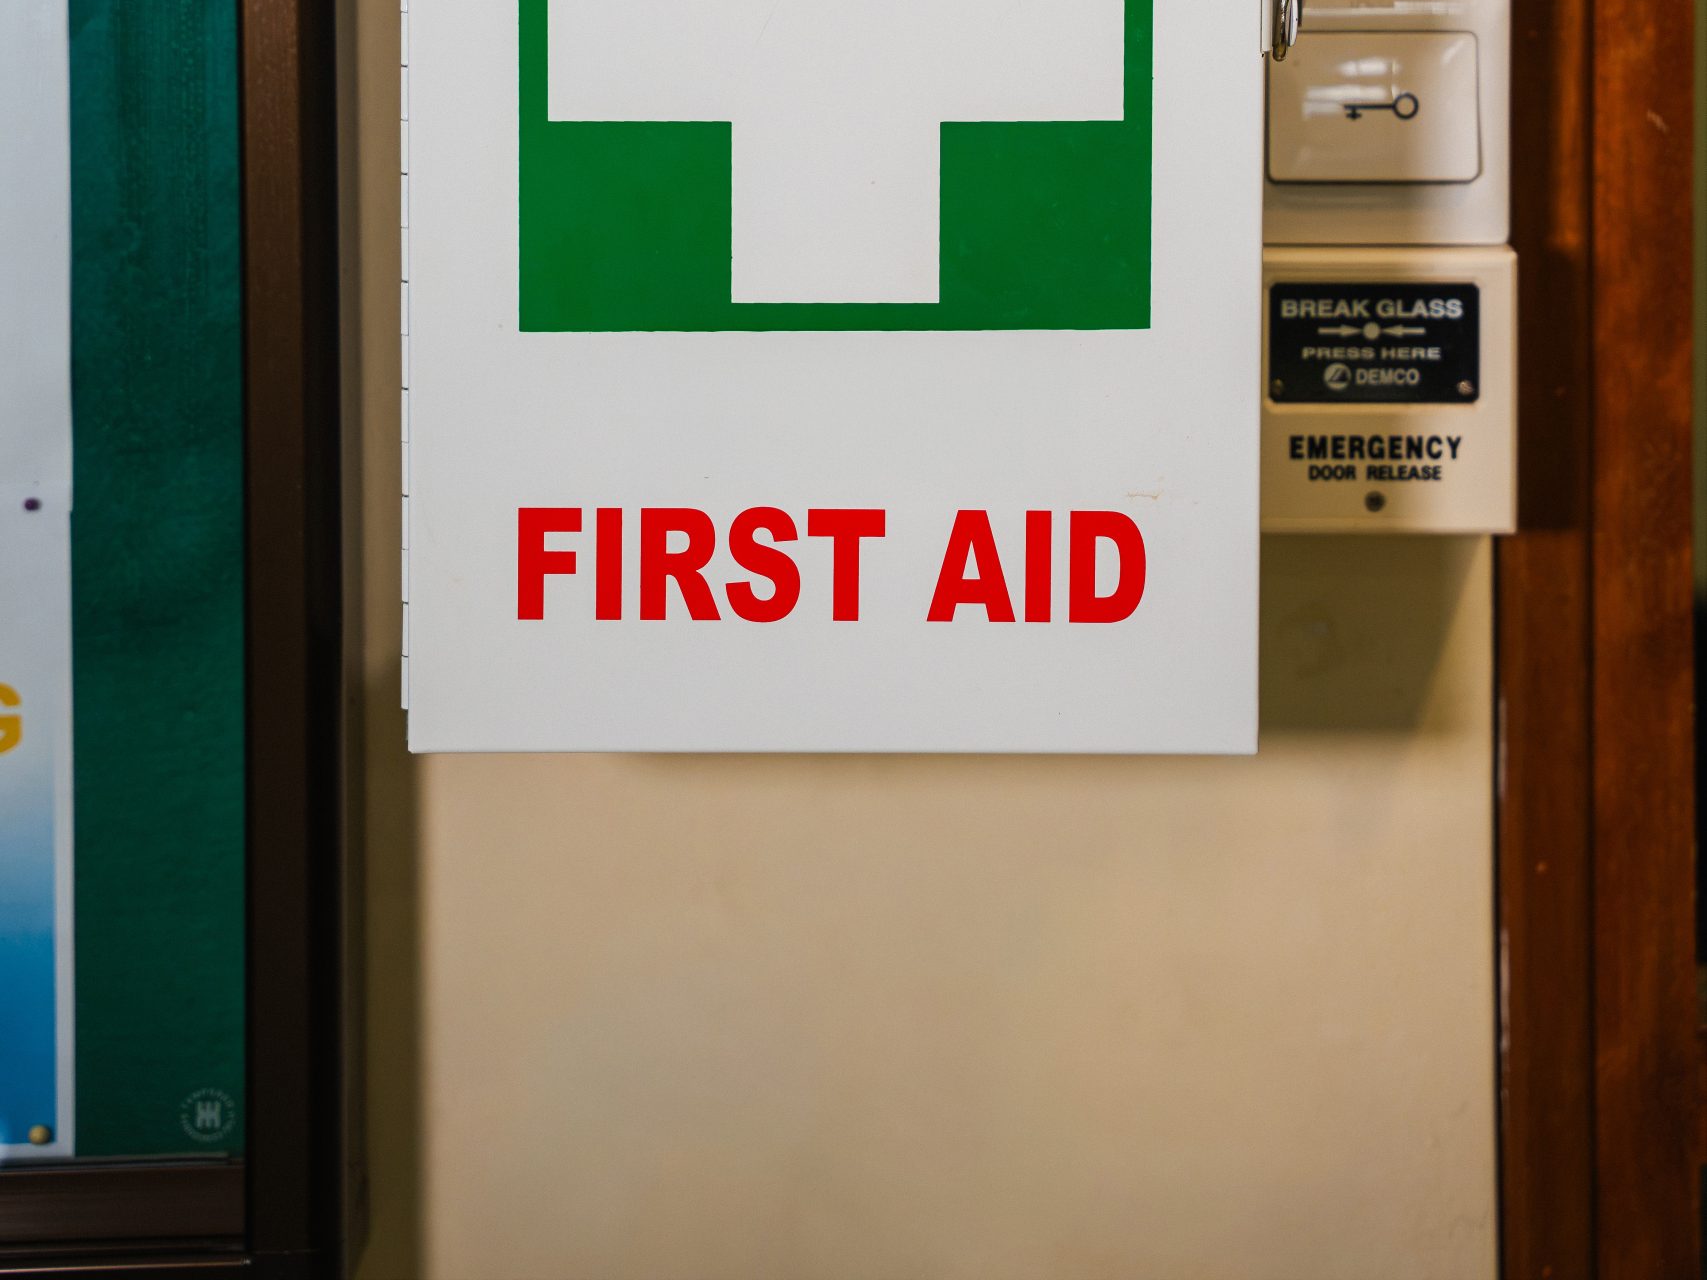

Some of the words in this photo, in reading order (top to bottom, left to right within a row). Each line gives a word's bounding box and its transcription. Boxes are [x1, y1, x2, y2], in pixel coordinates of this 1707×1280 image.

[1280, 299, 1370, 319] BREAK
[1375, 299, 1464, 319] GLASS
[1302, 346, 1375, 360] PRESS
[1381, 346, 1441, 360] HERE
[1355, 368, 1420, 385] DEMCO
[1289, 435, 1462, 460] EMERGENCY
[1308, 465, 1357, 481] DOOR
[1366, 465, 1442, 481] RELEASE
[517, 506, 886, 623] FIRST
[926, 509, 1147, 624] AID
